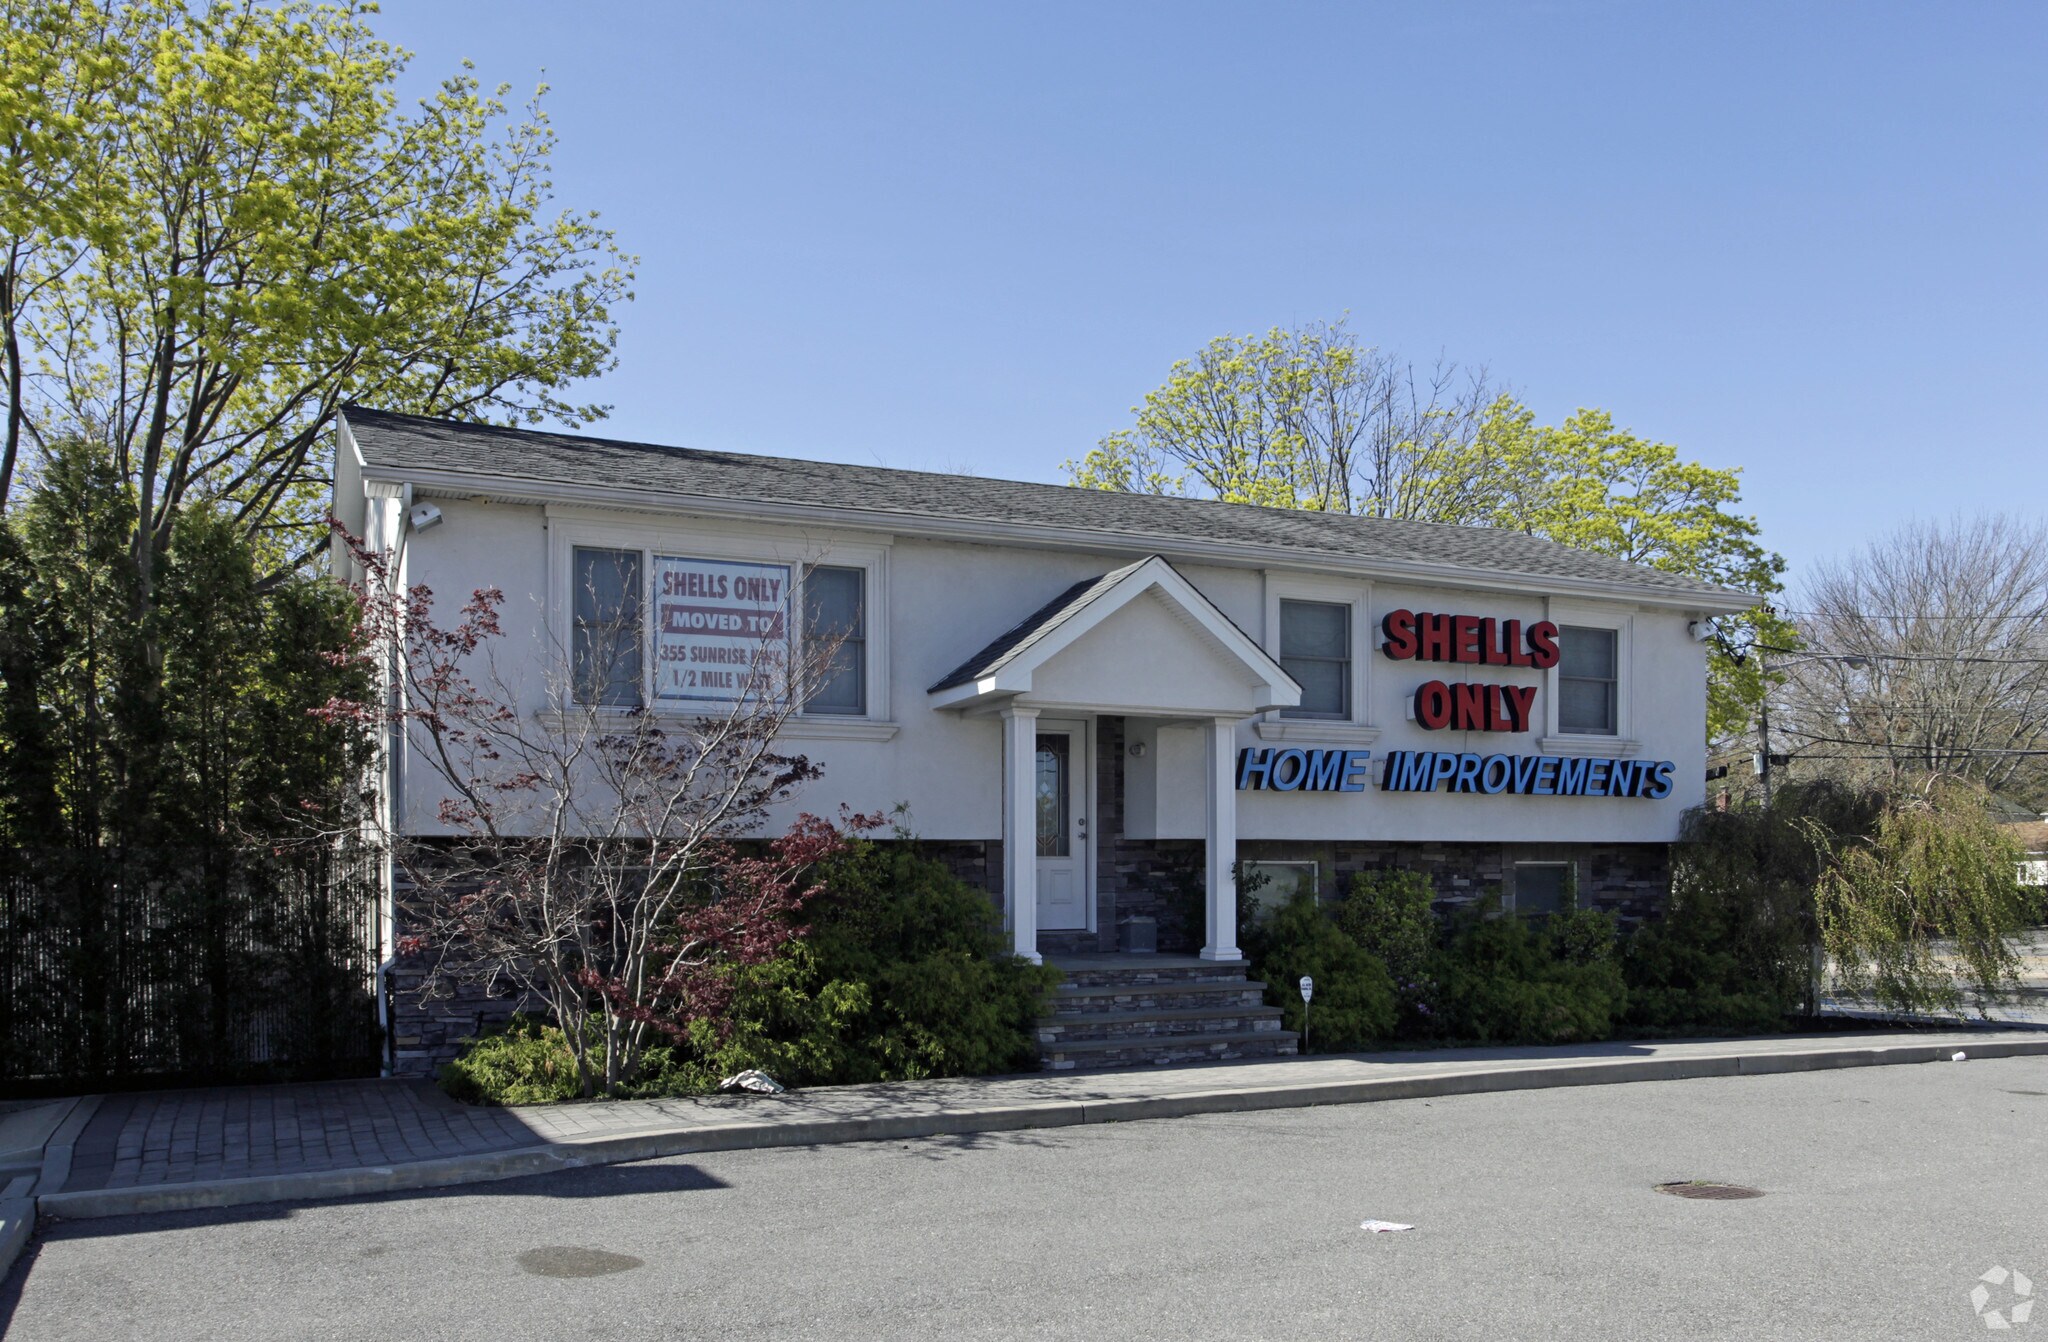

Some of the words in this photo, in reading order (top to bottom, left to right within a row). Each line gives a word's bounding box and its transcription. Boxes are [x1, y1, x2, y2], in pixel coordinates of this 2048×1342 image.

[662, 571, 728, 599] SHELLS
[734, 576, 781, 602] ONLY
[672, 611, 742, 631] MOVED
[747, 616, 773, 632] TO
[1382, 609, 1560, 669] SHELLS
[661, 645, 686, 662] 355
[690, 646, 746, 665] SUNRISE
[673, 669, 696, 689] 1/2
[701, 671, 732, 689] MILE
[1413, 680, 1537, 732] ONLY
[1236, 747, 1370, 793] HOME
[1382, 751, 1676, 799] IMPROVEMENTS
